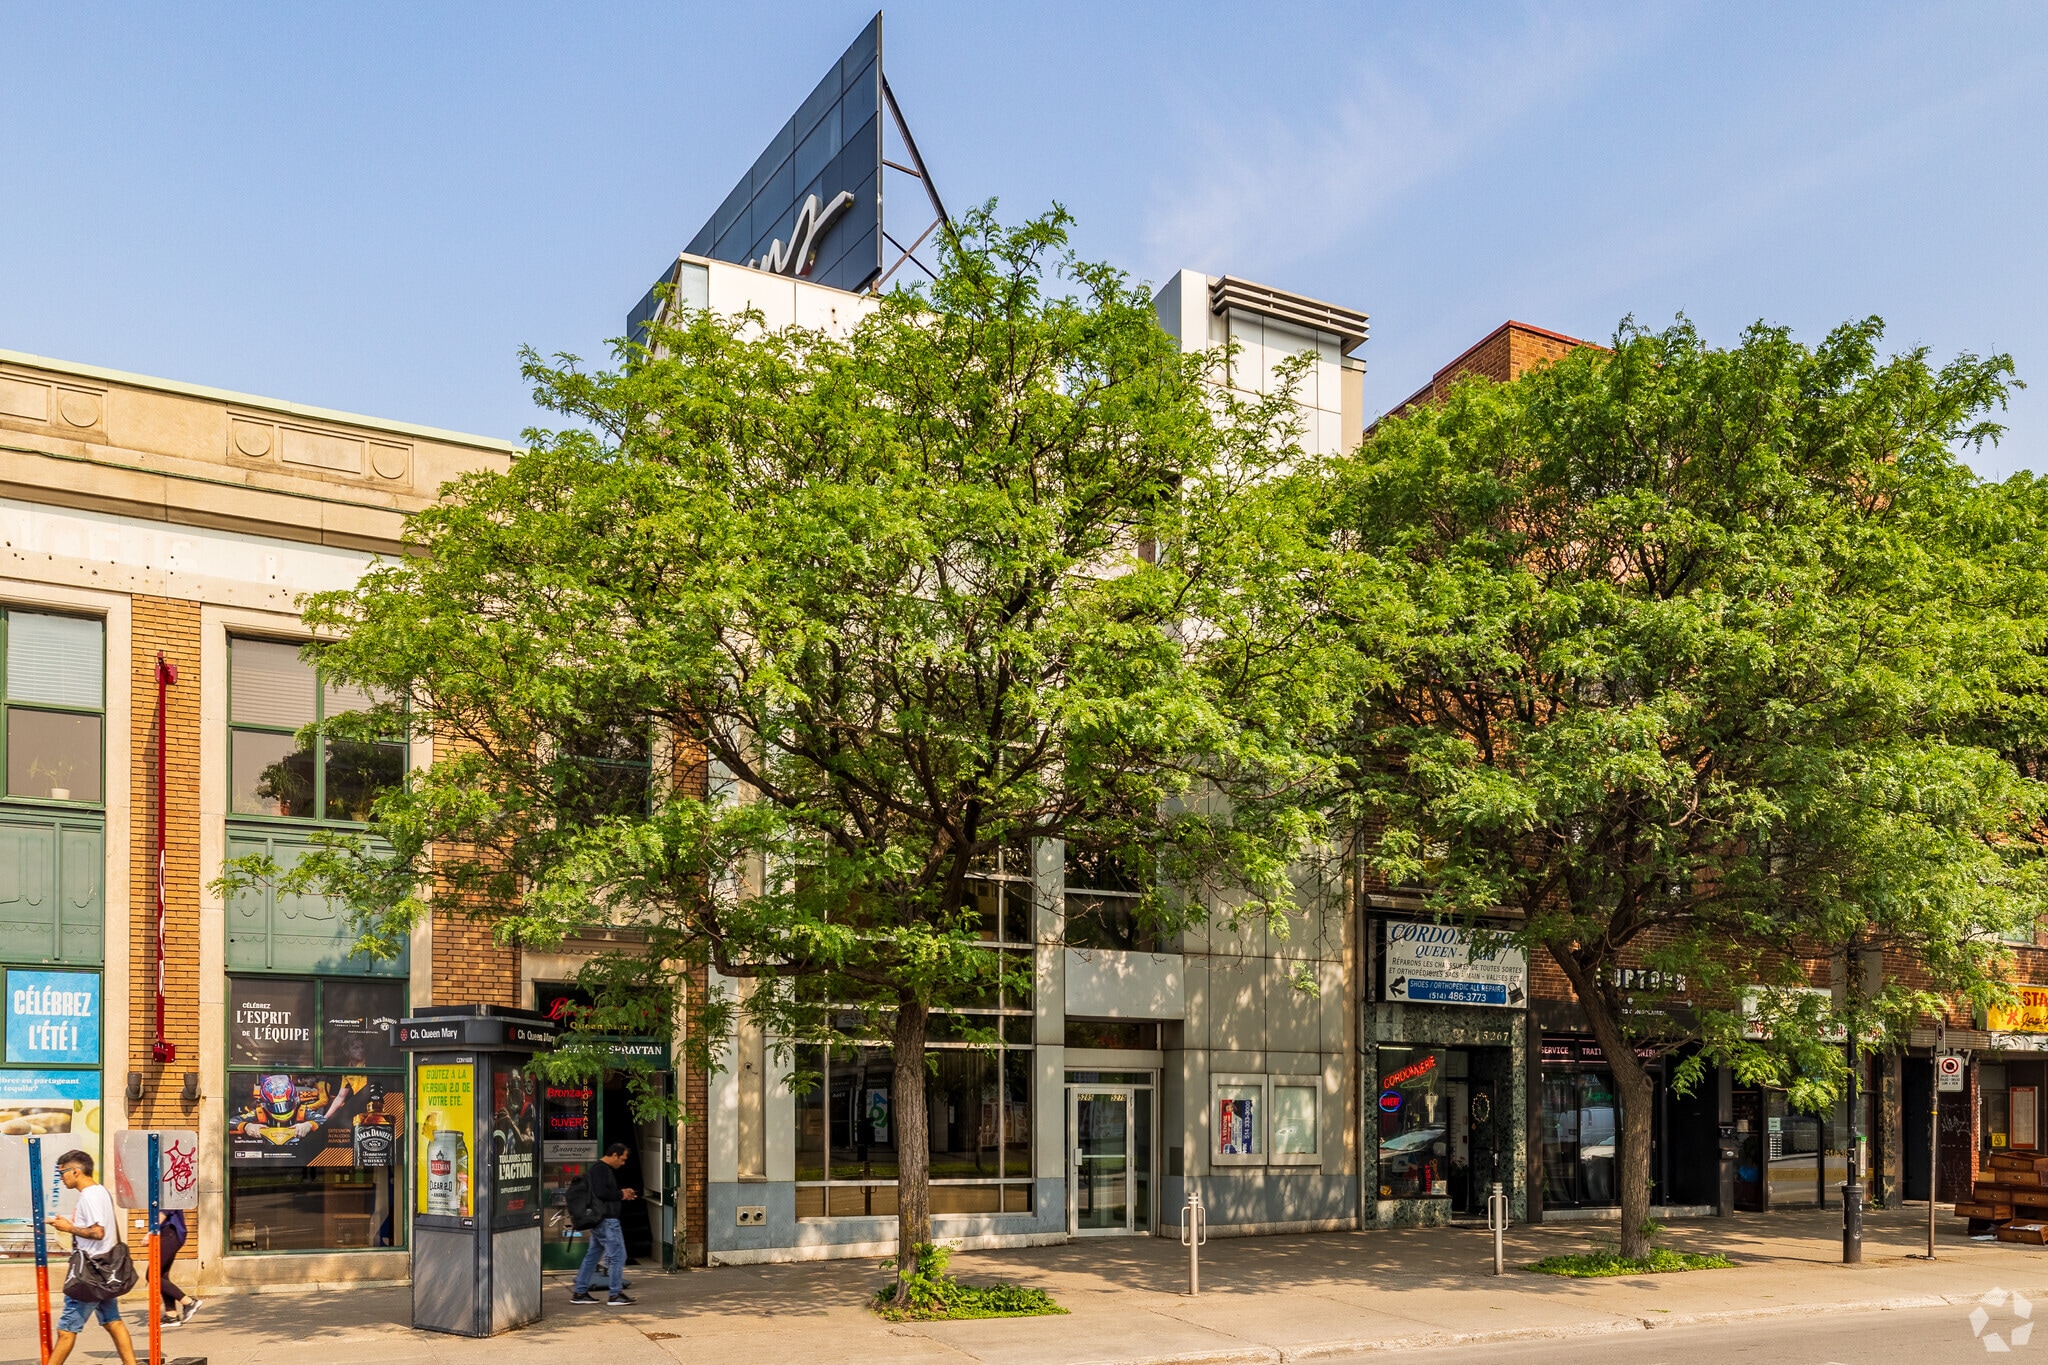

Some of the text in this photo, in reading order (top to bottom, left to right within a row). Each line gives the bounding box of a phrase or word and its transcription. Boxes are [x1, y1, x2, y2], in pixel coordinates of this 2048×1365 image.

[1415, 945, 1457, 959] QUEEN
[1392, 957, 1421, 967] RÉPARONS
[1423, 959, 1433, 967] LES
[1434, 960, 1470, 970] CHASSURES
[1480, 964, 1500, 972] TOUTES
[1502, 966, 1522, 974] SORTES
[1410, 980, 1429, 988] SHOES
[1433, 982, 1469, 991] ORTHOPEDIC
[1481, 984, 1505, 993] REPAIRS
[14, 985, 91, 1016] CÉLÉBREZ
[1448, 991, 1487, 1002] 486-3773
[236, 1010, 291, 1025] L'ESPRIT
[29, 1020, 78, 1051] L'ÉTÉ !
[254, 1024, 310, 1043] L'ÉQUIPE
[410, 1027, 458, 1040] Ch. Queen Mary
[527, 1030, 543, 1041] Queen
[1482, 1030, 1509, 1041] 5267
[1541, 1046, 1569, 1055] SERVICE
[458, 1068, 467, 1079] LA
[34, 1078, 79, 1086] partageant
[422, 1082, 471, 1093] VERSION 2.0 DE
[4, 1084, 38, 1093] tequila?
[547, 1088, 593, 1099] Bronzage
[428, 1095, 448, 1106] VOTRE
[357, 1130, 371, 1141] JACK
[550, 1144, 592, 1154] Bronzage
[499, 1153, 532, 1163] TOUJOURS DANS
[432, 1163, 450, 1171] SLEEMAN
[499, 1162, 533, 1180] L'ACTION
[430, 1180, 443, 1191] CLEAR
